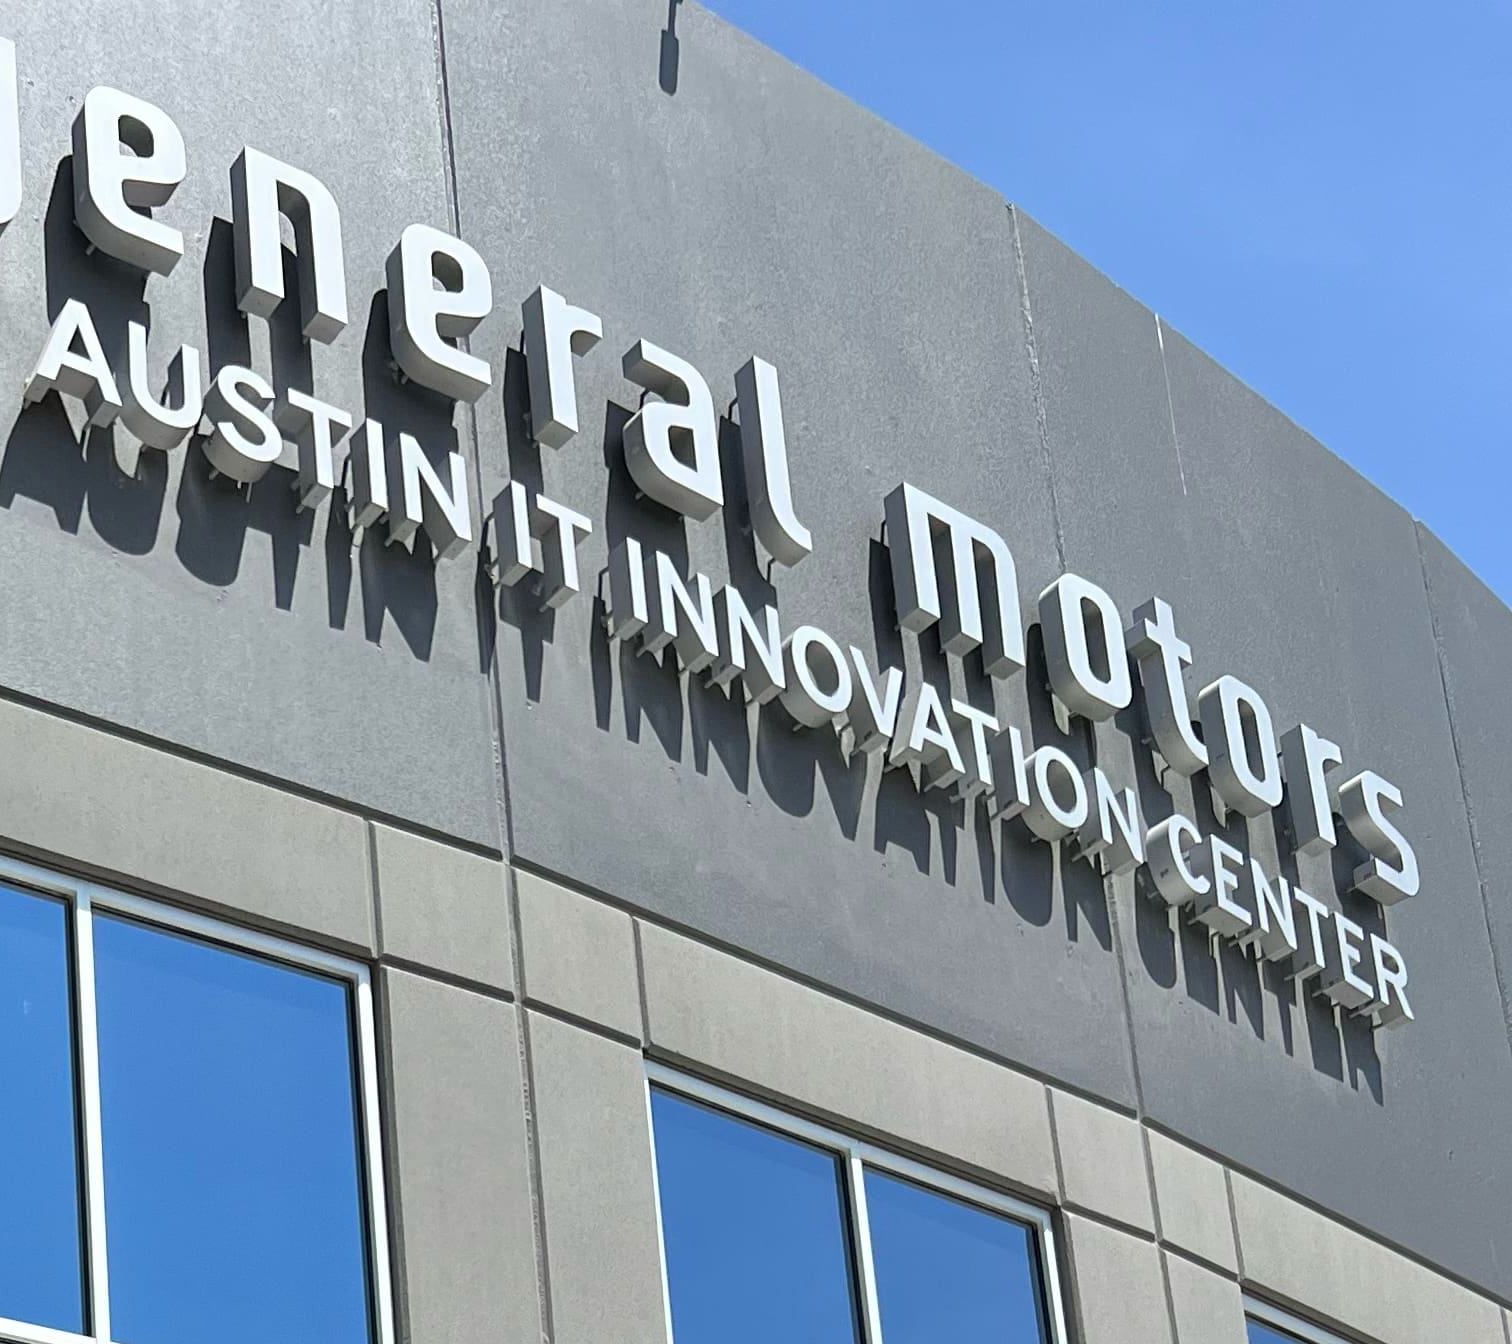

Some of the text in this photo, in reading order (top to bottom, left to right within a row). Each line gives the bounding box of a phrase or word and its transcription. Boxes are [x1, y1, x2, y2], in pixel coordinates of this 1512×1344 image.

[23, 299, 1414, 1029] AUSTIN IT INNOVATION CENTER
[884, 482, 1420, 905] motors
